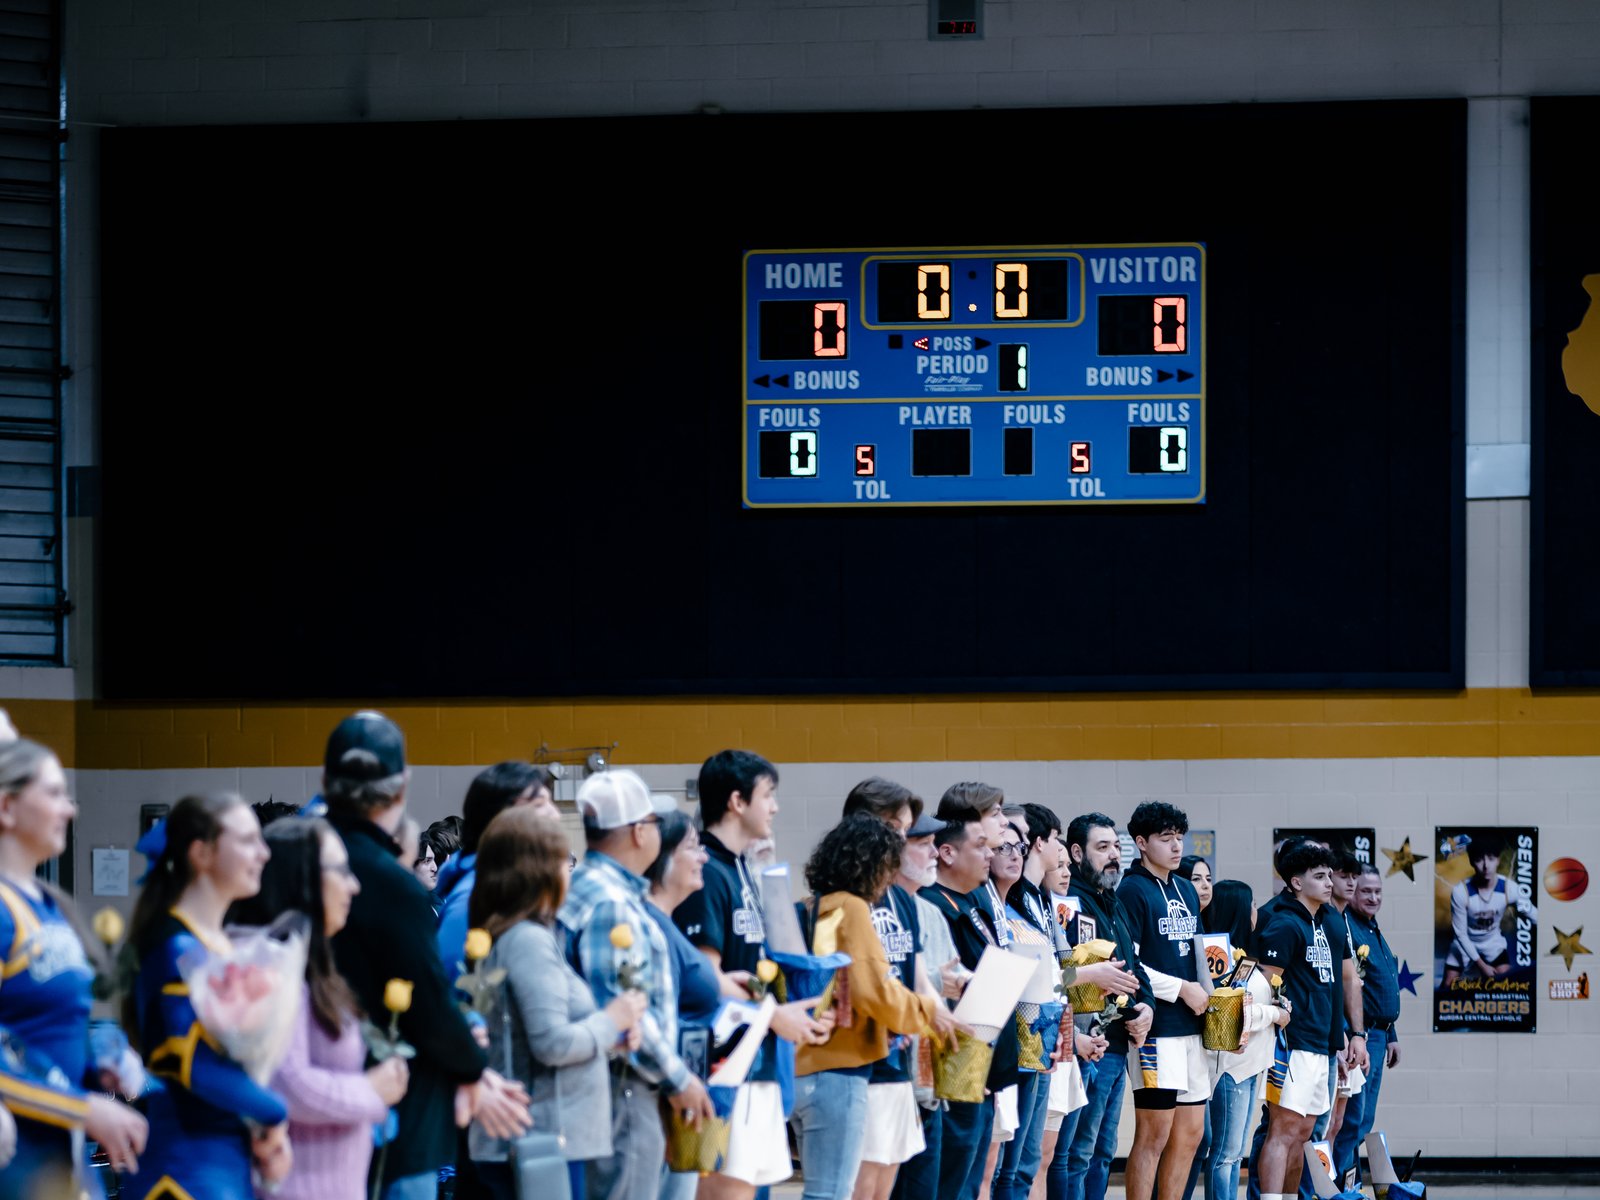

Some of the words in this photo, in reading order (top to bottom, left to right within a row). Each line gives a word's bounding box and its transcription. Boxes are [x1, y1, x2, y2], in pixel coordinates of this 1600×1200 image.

[765, 262, 843, 289] HOME
[1090, 256, 1197, 284] VISITOR
[814, 302, 846, 357] 0
[1153, 297, 1186, 352] 0
[933, 336, 972, 351] POSS
[916, 354, 989, 375] PERIOD
[1017, 346, 1027, 389] 1
[794, 370, 860, 390] BONUS
[1086, 366, 1153, 386] BONUS
[759, 408, 821, 427] FOULS
[899, 405, 972, 425] PLAYER
[1003, 404, 1066, 424] FOULS
[1128, 402, 1190, 422] FOULS
[790, 431, 817, 476] 0
[1159, 427, 1186, 471] 0
[853, 481, 891, 500] TOL
[1067, 478, 1105, 498] TOL
[1517, 834, 1533, 914] SENIOR
[1516, 917, 1532, 966] 2023
[1206, 957, 1225, 975] 20
[1439, 1000, 1530, 1014] CHARGERS
[1464, 1014, 1492, 1022] CENTRAL
